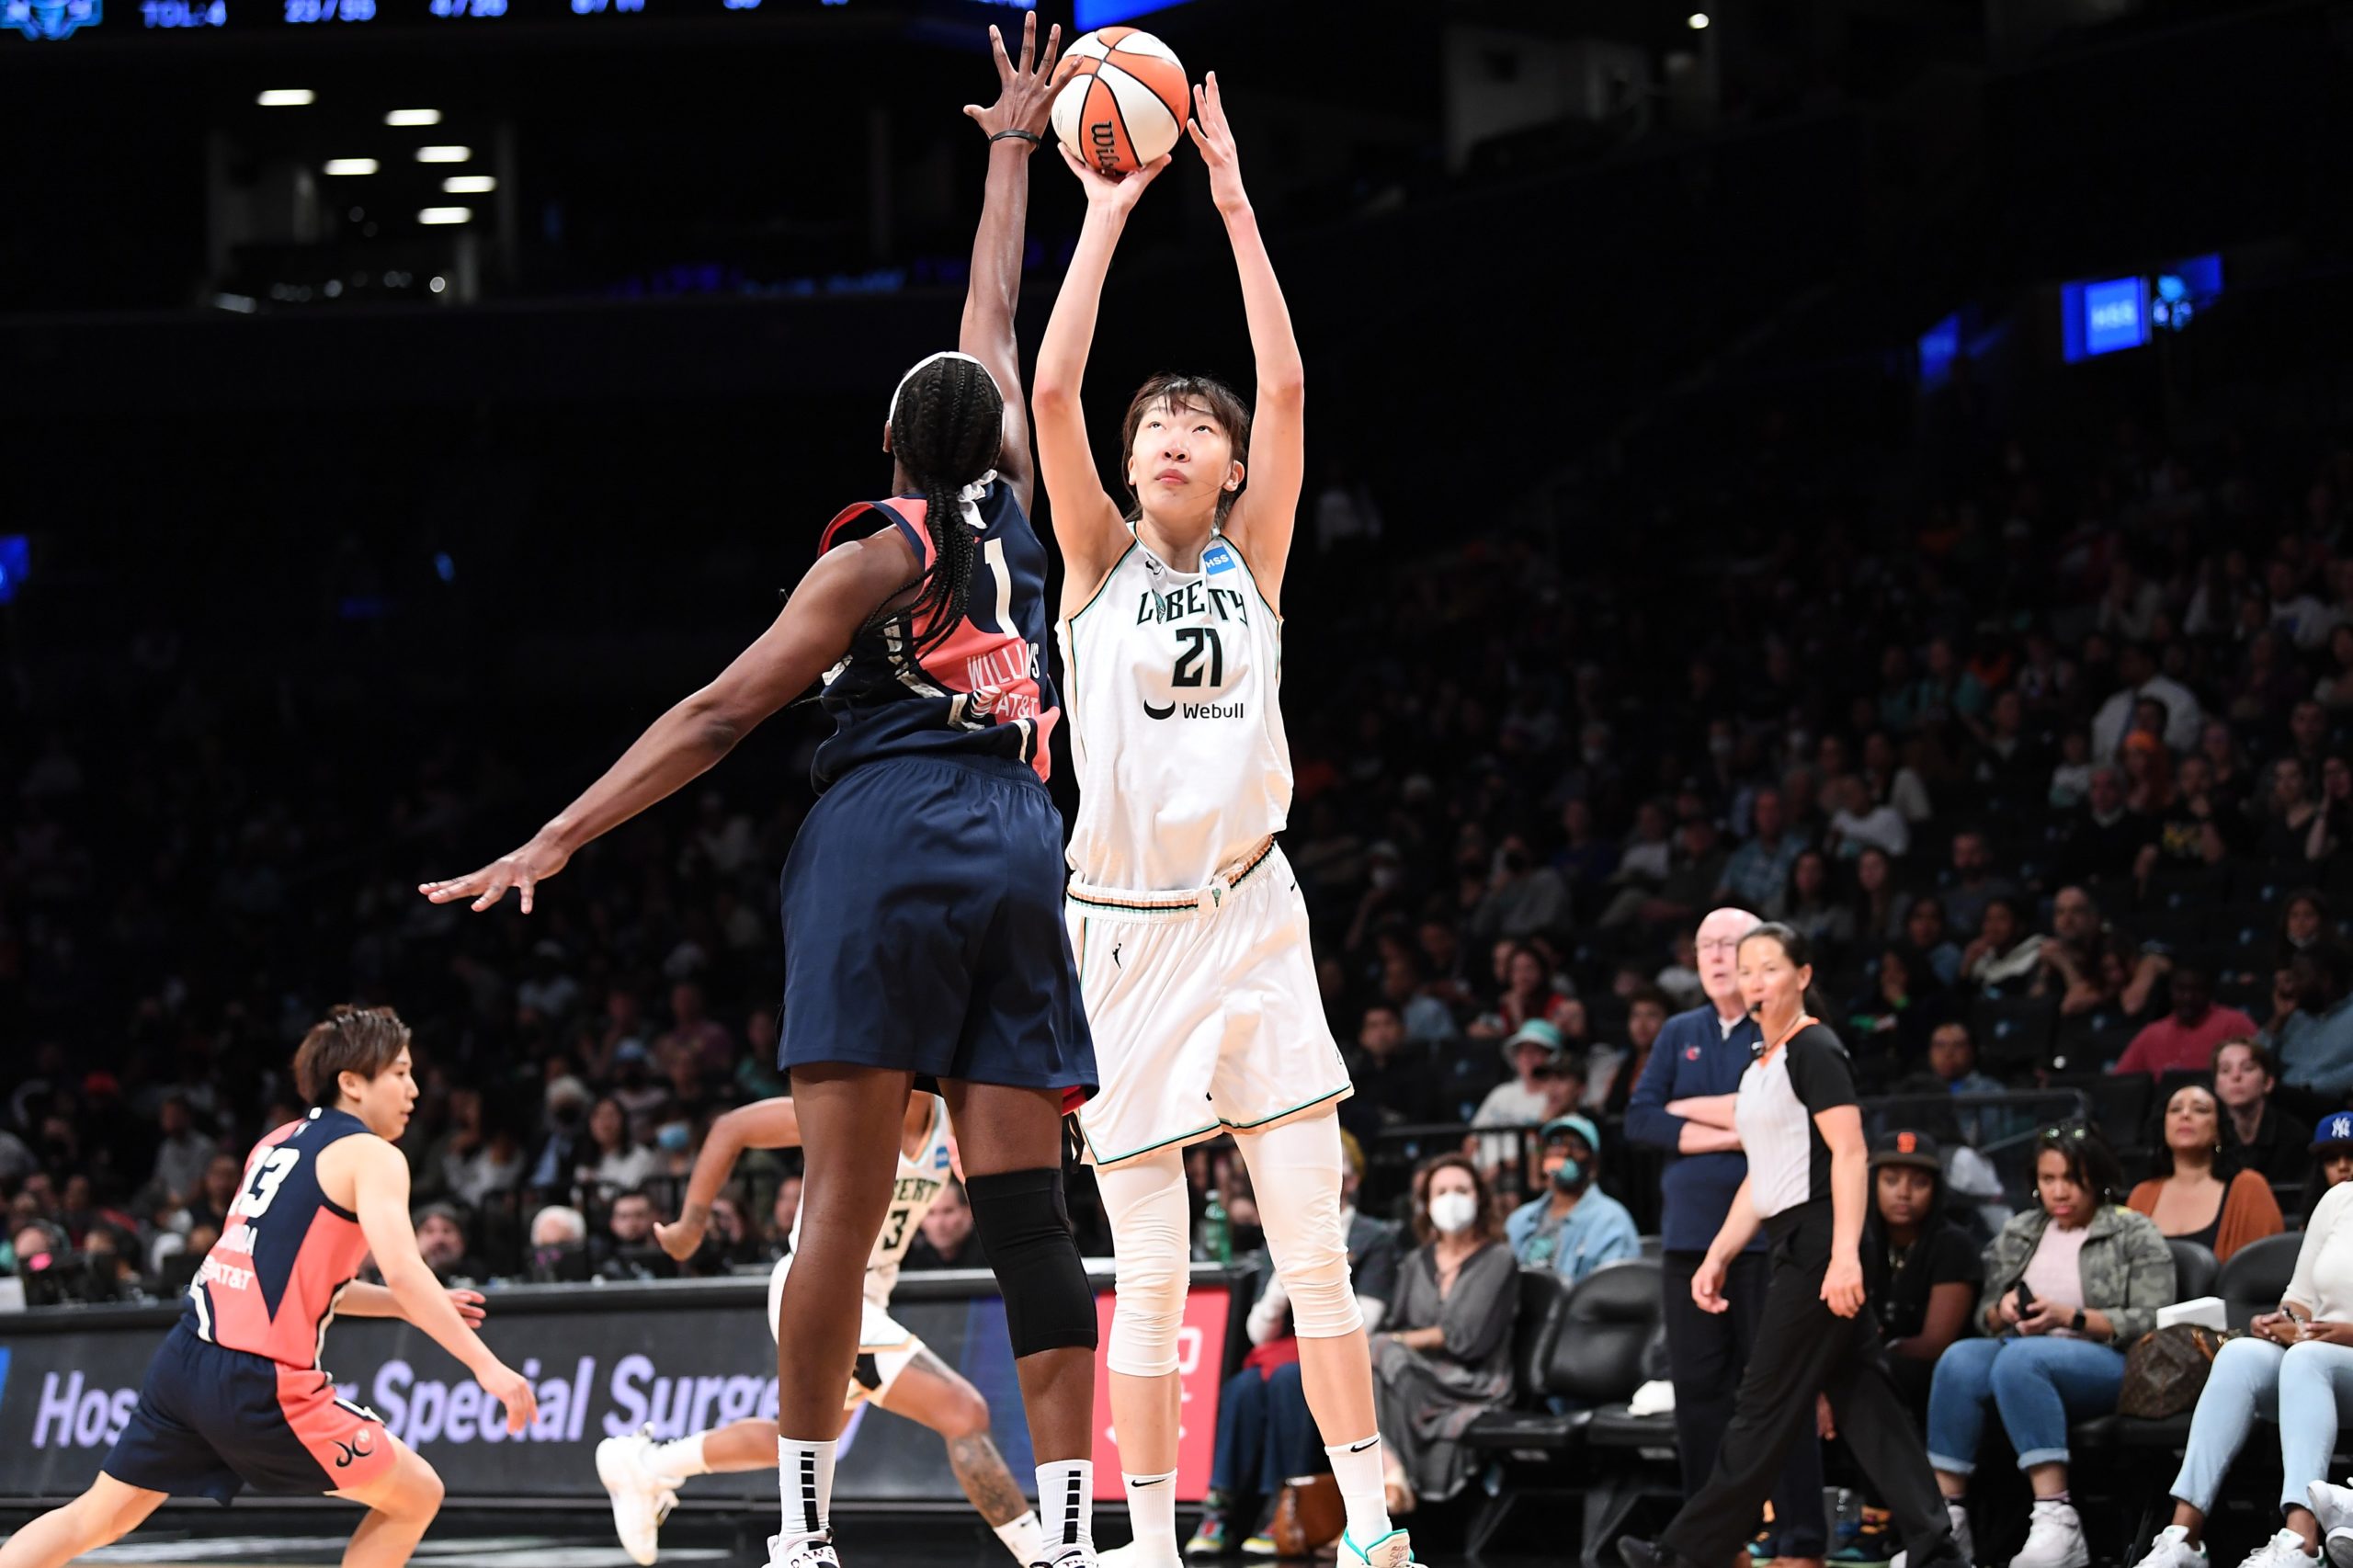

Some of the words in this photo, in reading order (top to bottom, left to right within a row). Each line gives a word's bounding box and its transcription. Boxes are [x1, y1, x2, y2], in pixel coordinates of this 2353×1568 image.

[1205, 553, 1229, 568] HSS
[983, 538, 1020, 640] 1
[1136, 580, 1249, 628] LIBETY
[1171, 628, 1222, 687] 21
[995, 692, 1039, 719] AT&T
[1183, 703, 1245, 720] Webull
[228, 1145, 301, 1219] 13
[882, 1209, 911, 1251] 3
